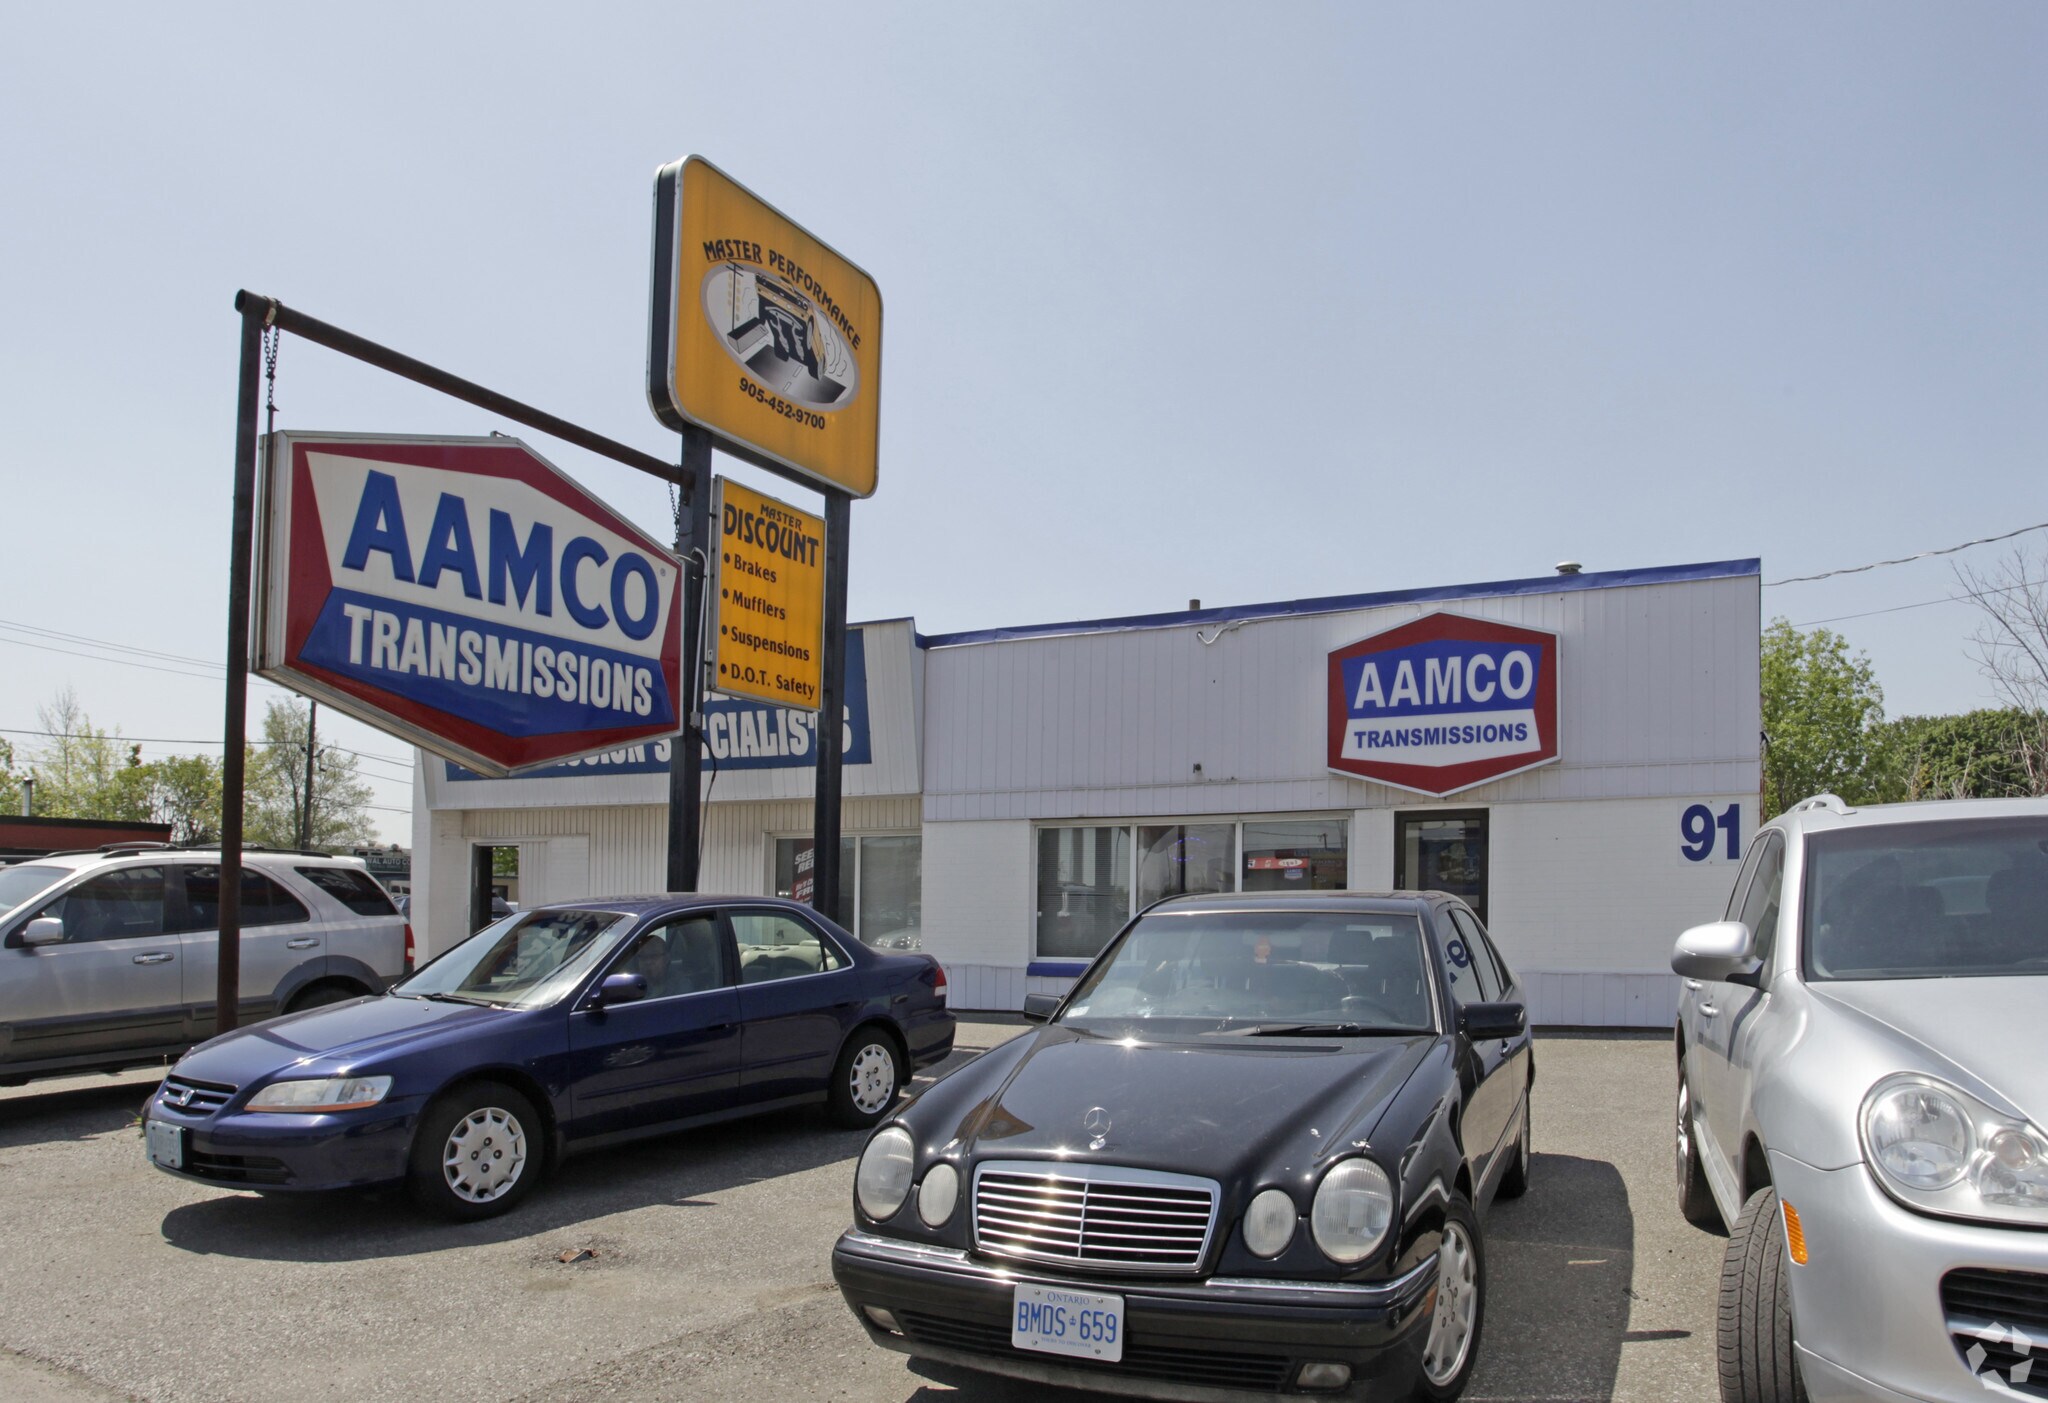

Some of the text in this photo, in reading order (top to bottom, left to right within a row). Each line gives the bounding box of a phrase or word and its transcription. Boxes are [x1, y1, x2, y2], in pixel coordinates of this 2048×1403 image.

[703, 239, 861, 350] MASTER PERFORMANCE
[739, 377, 825, 430] 905-452-9700
[723, 502, 819, 567] DISCOUNT
[760, 503, 803, 531] MASTER
[341, 469, 660, 641] AAMCO
[734, 553, 777, 584] Brakes
[732, 589, 786, 620] Mufflers
[343, 603, 652, 716] TRANSMISSIONS
[731, 626, 810, 661] Suspensions
[731, 663, 815, 700] D.O.T. Safety
[1353, 650, 1533, 709] AAMCO
[1354, 723, 1528, 749] TRANSMISSIONS
[1681, 803, 1740, 862] 91
[1047, 1291, 1090, 1306] ONTARIO
[1017, 1301, 1117, 1344] BMDS 659
